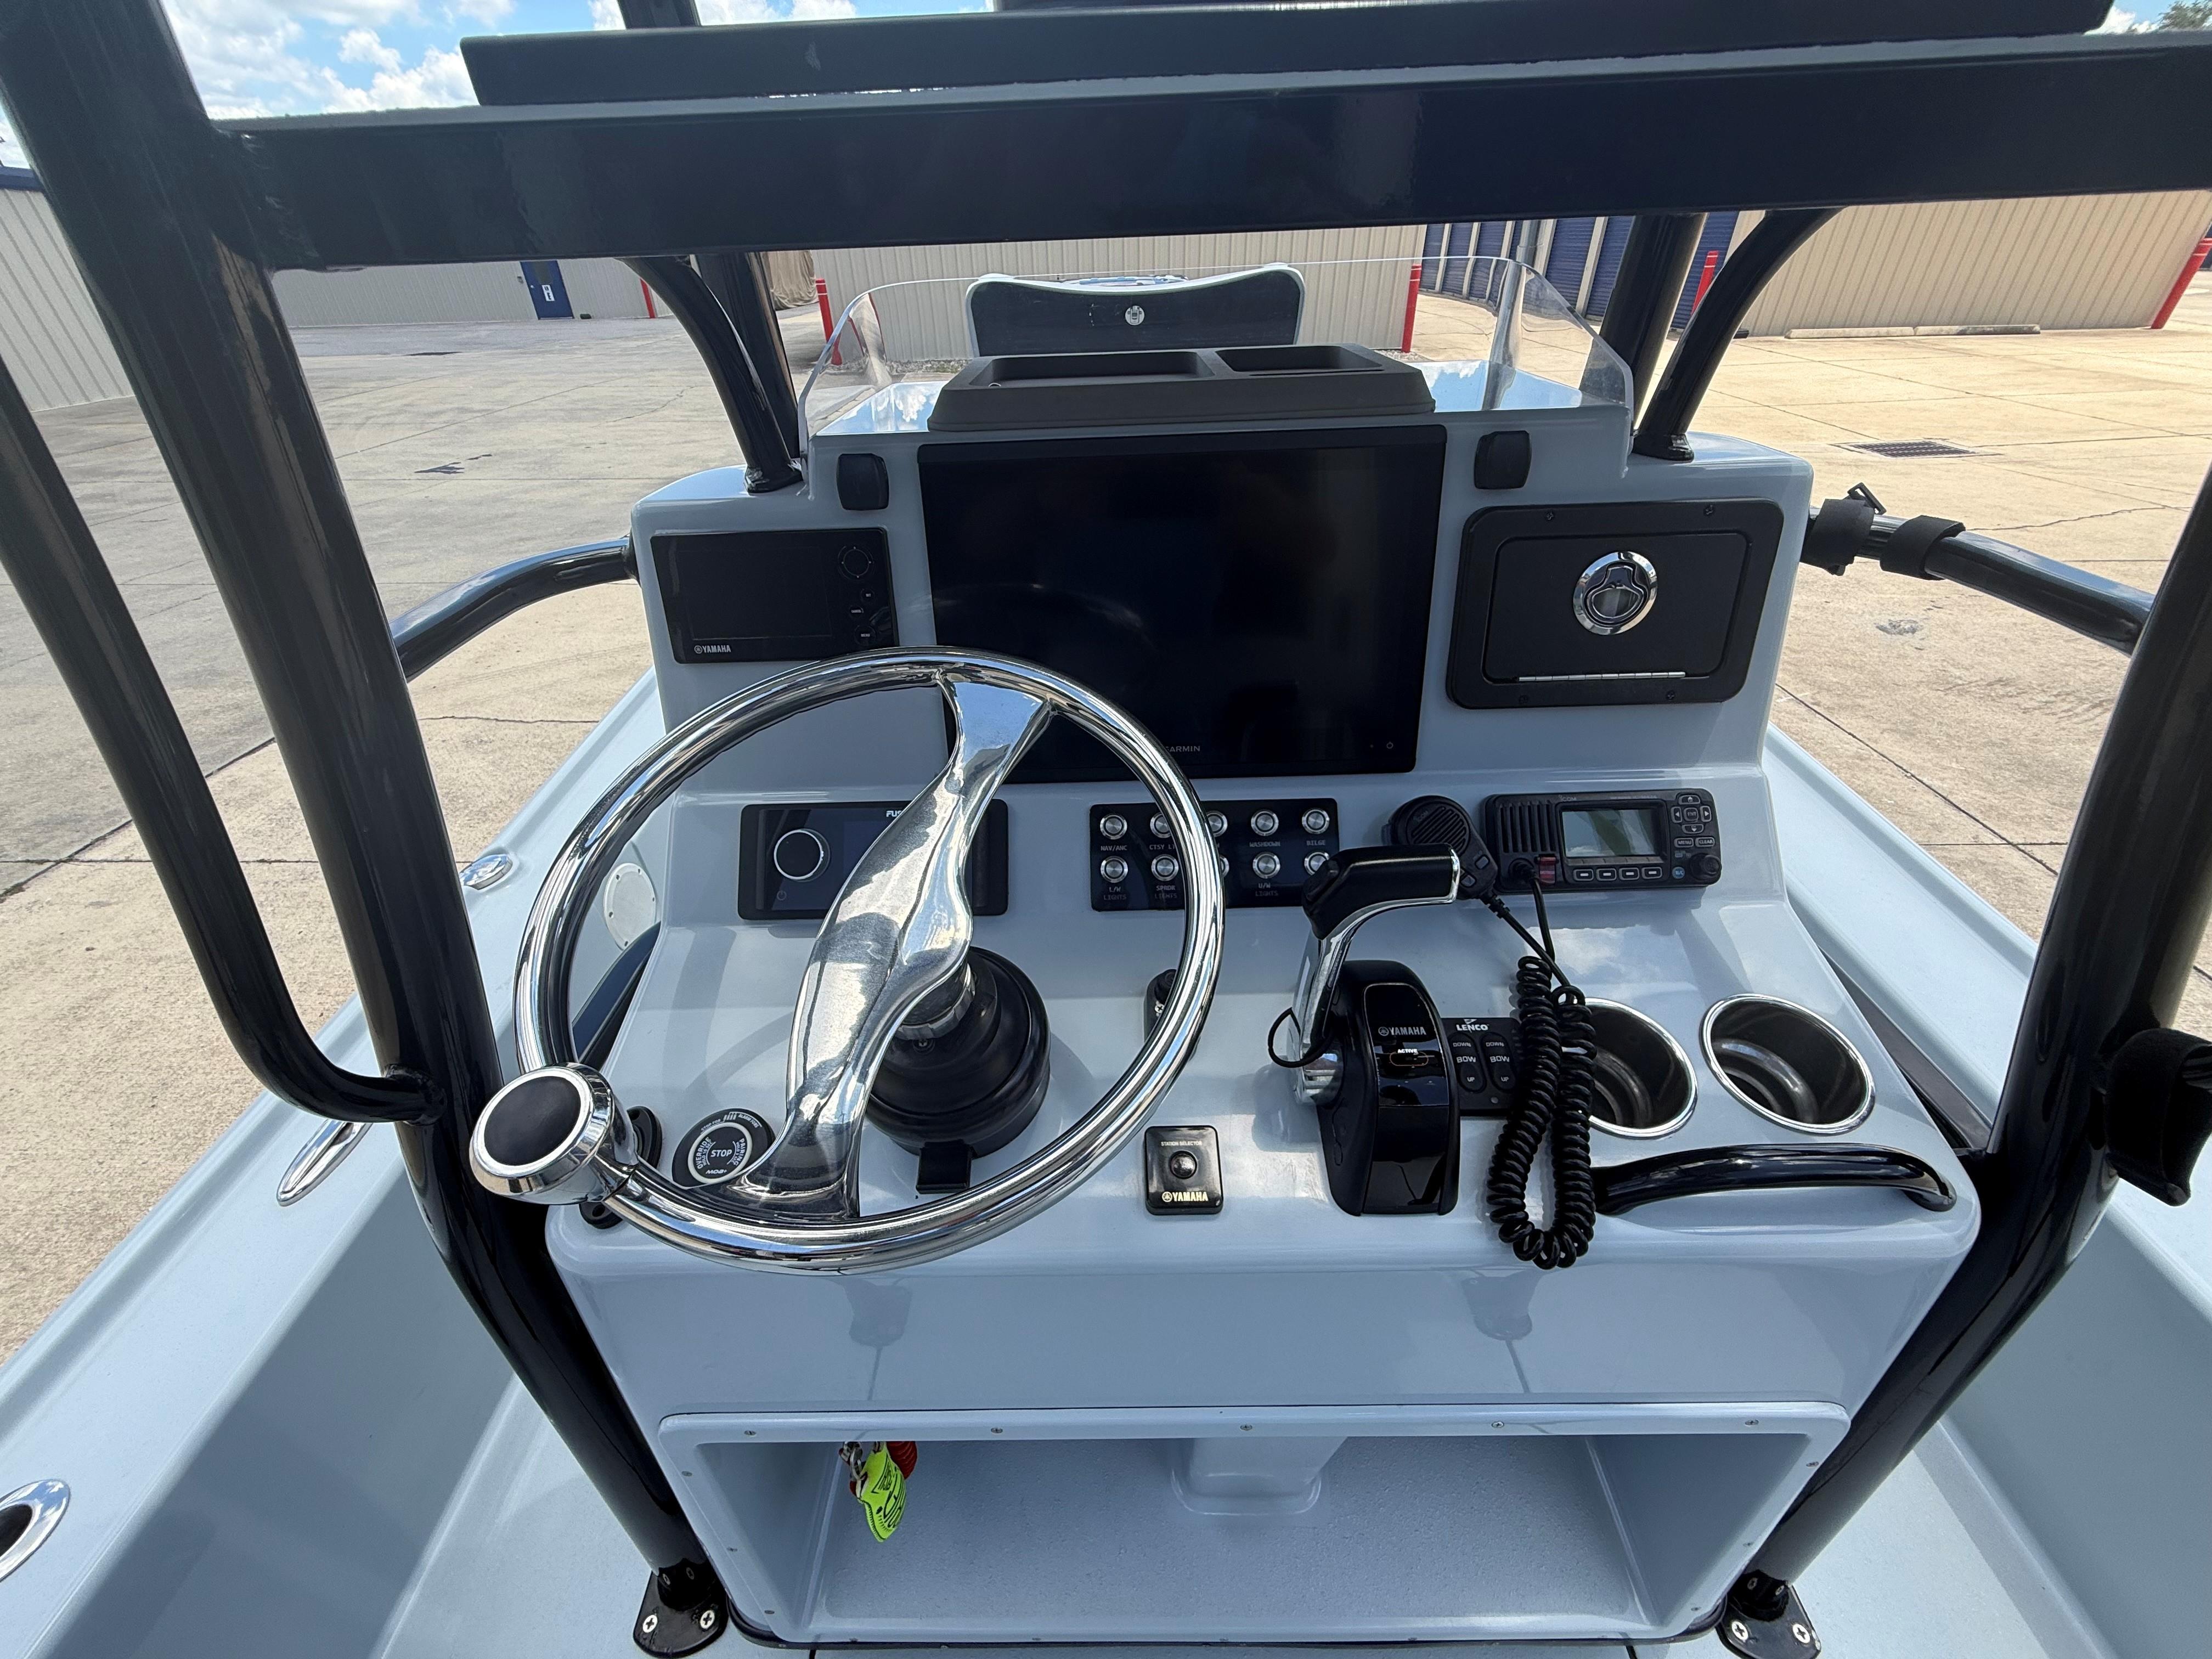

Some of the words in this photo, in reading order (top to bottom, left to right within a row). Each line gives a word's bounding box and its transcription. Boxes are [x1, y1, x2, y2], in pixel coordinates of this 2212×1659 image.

[702, 645, 732, 653] YAMAHA
[1389, 1026, 1427, 1036] YAMAHA
[1456, 1024, 1488, 1032] LENCO
[695, 1136, 712, 1169] OVERRIDE
[710, 1149, 732, 1158] STOP
[733, 1138, 746, 1166] PAIRING
[1172, 1191, 1209, 1201] YAMAHA
